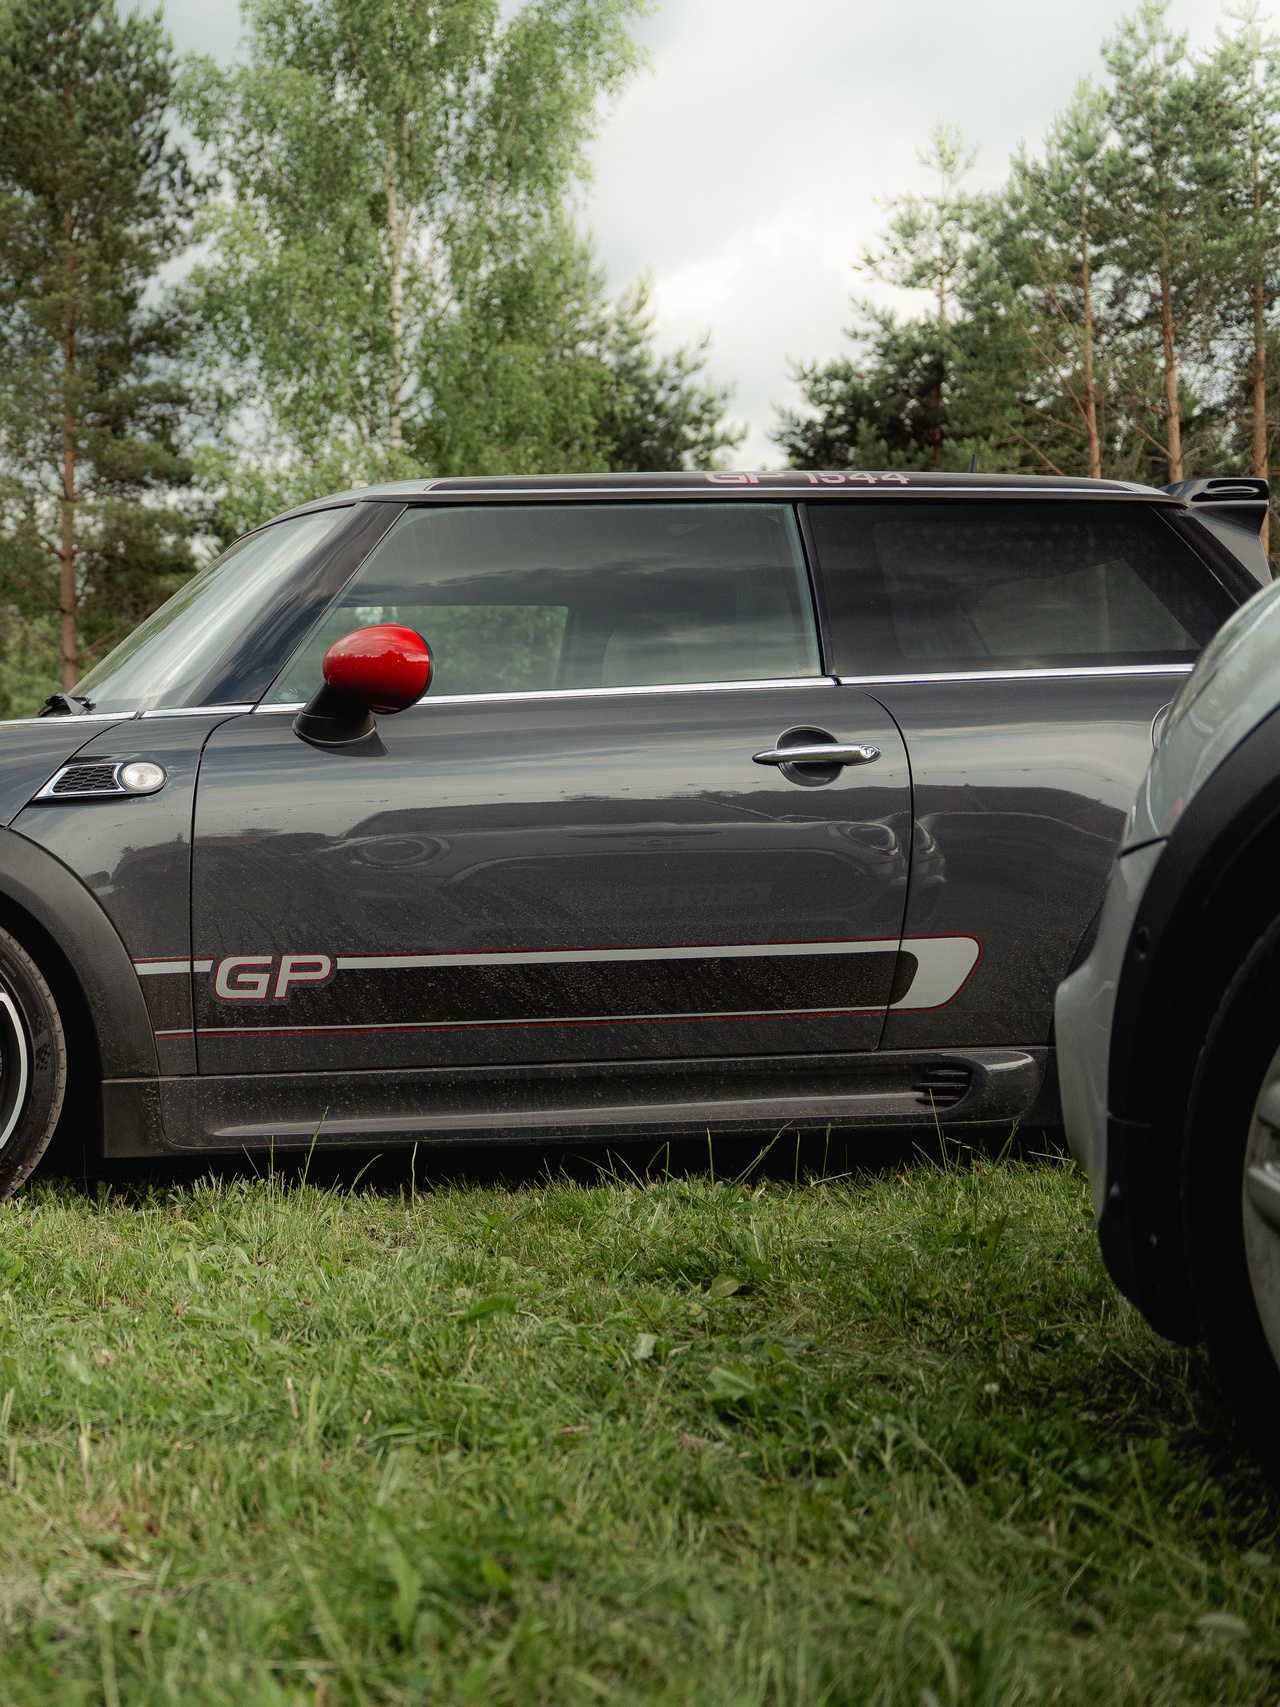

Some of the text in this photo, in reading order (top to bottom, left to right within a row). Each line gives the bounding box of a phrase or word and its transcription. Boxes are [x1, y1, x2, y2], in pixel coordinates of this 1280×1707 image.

[705, 472, 910, 484] GP 1544
[214, 953, 332, 1000] GP
